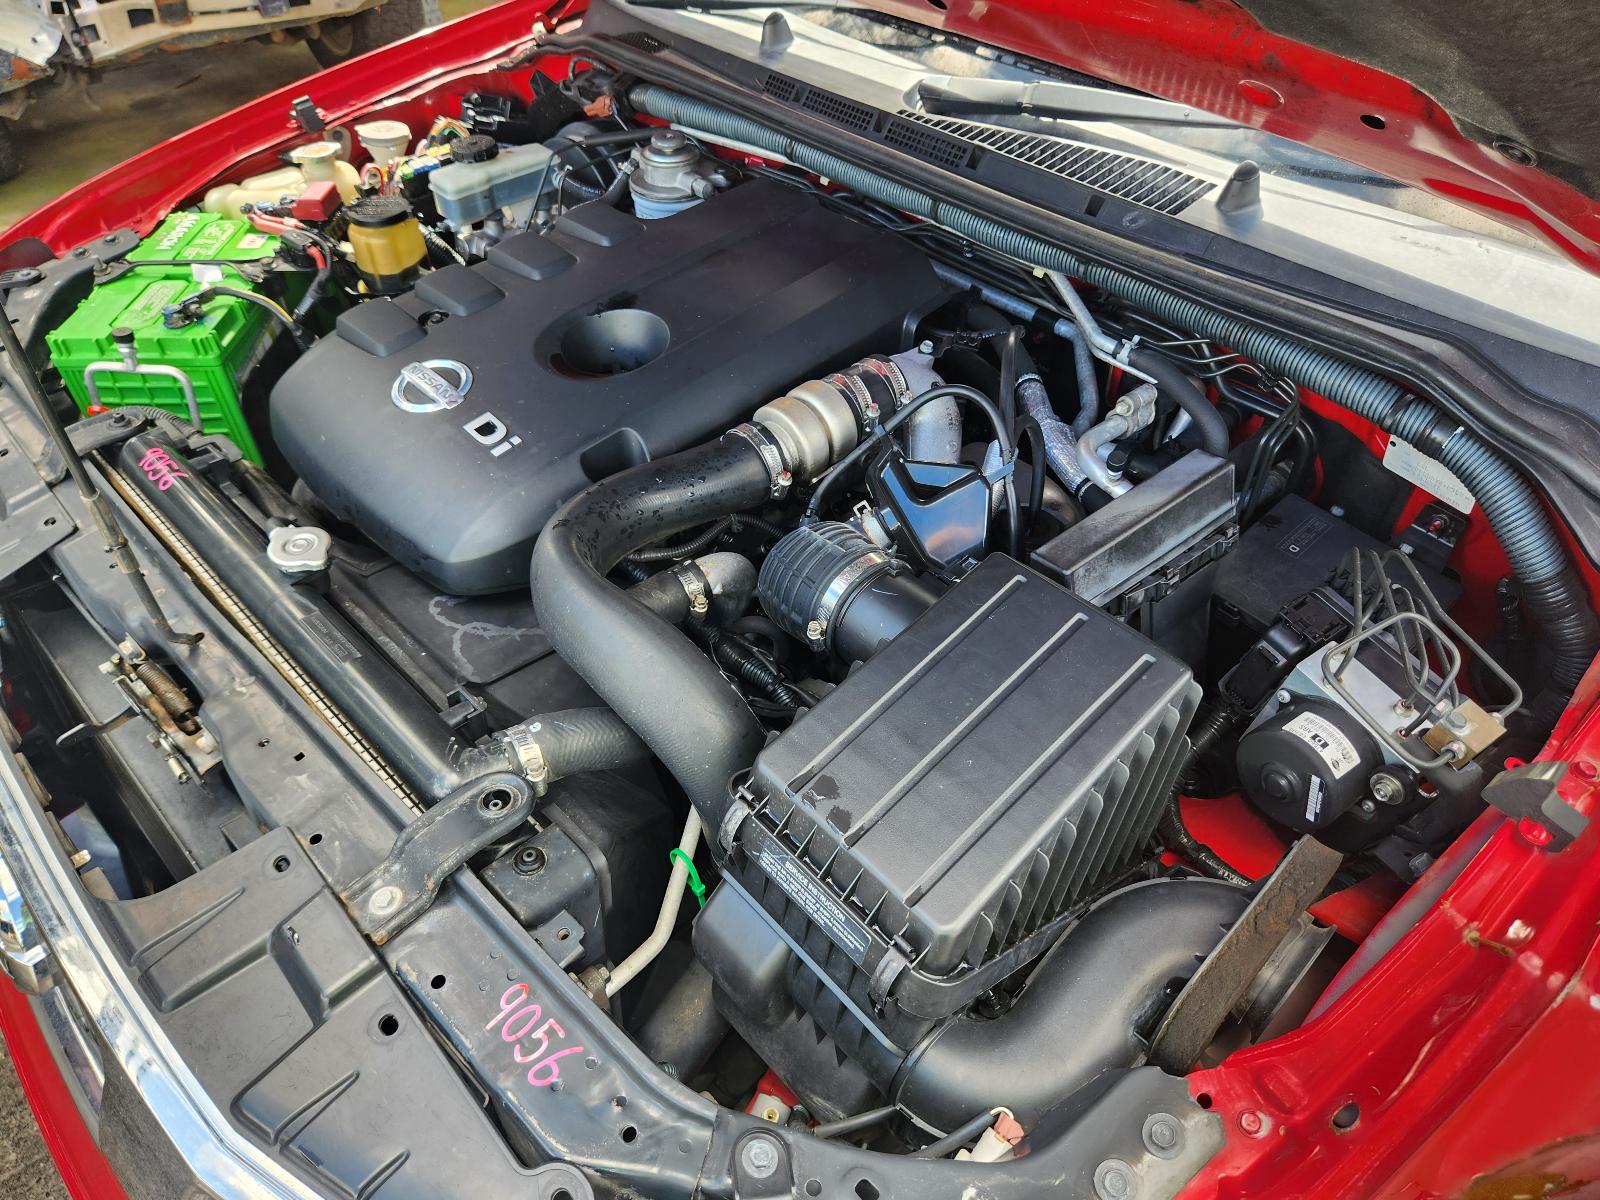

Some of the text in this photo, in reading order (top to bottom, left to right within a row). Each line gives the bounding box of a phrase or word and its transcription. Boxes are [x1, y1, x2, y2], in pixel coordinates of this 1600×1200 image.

[407, 365, 459, 402] NISSAN
[463, 411, 522, 457] Di
[138, 447, 190, 491] 9056
[784, 860, 846, 922] SERVICE INSTRUCTION
[485, 983, 584, 1087] 9056
